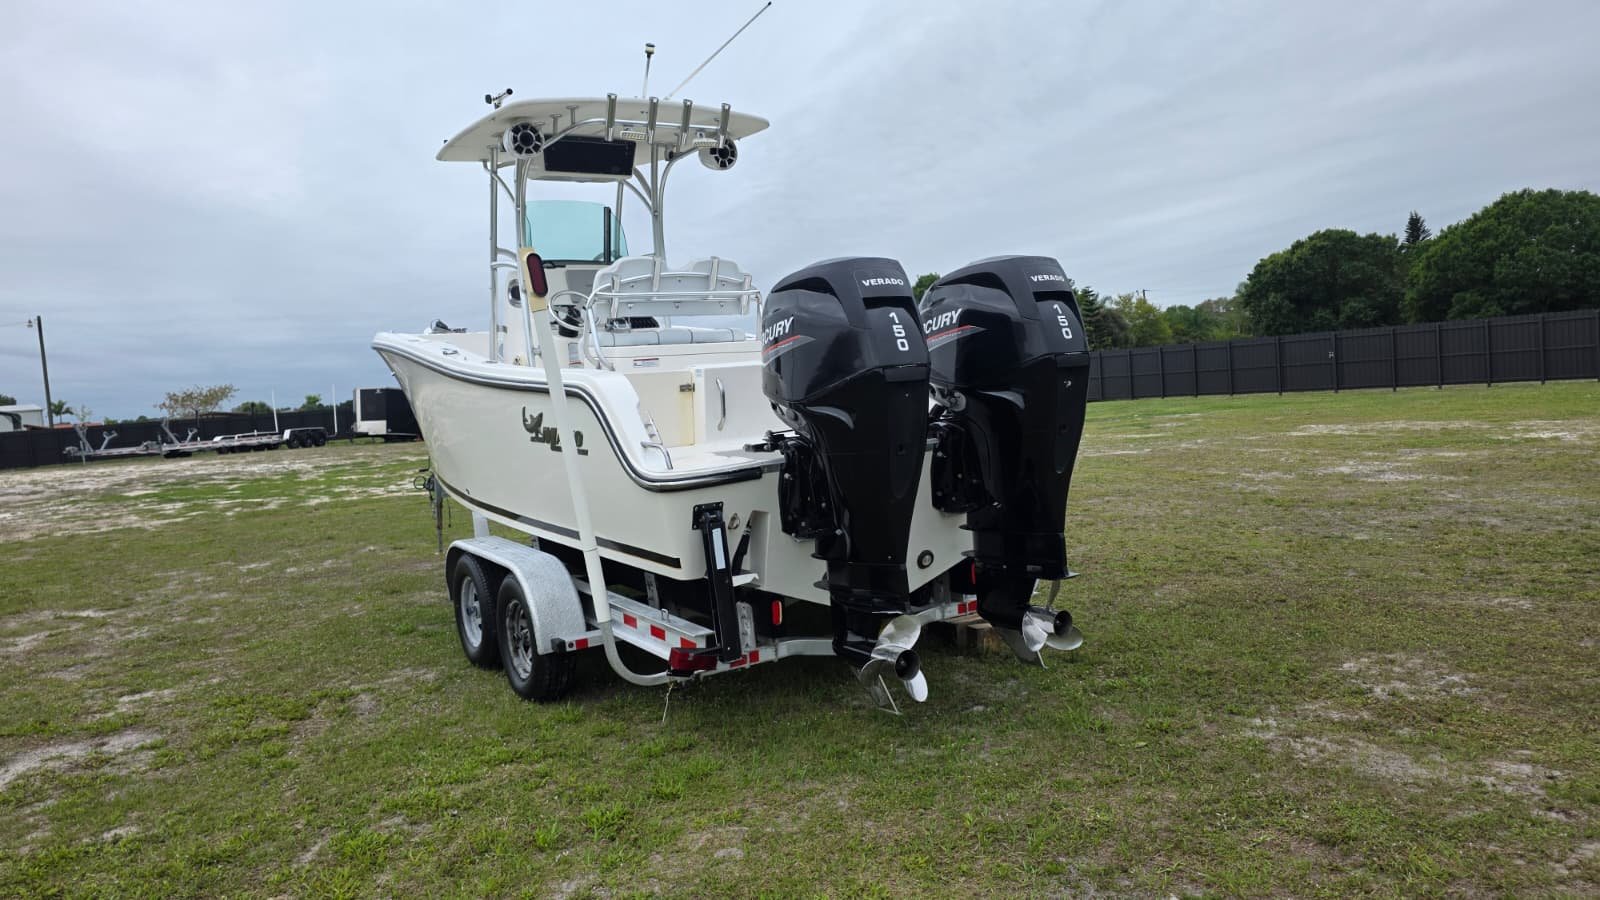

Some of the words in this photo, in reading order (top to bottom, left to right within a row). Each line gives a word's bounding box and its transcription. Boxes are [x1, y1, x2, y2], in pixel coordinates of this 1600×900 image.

[861, 278, 905, 287] VERADO
[1030, 274, 1066, 283] VERADO
[889, 311, 910, 352] 150
[1053, 303, 1073, 340] 150
